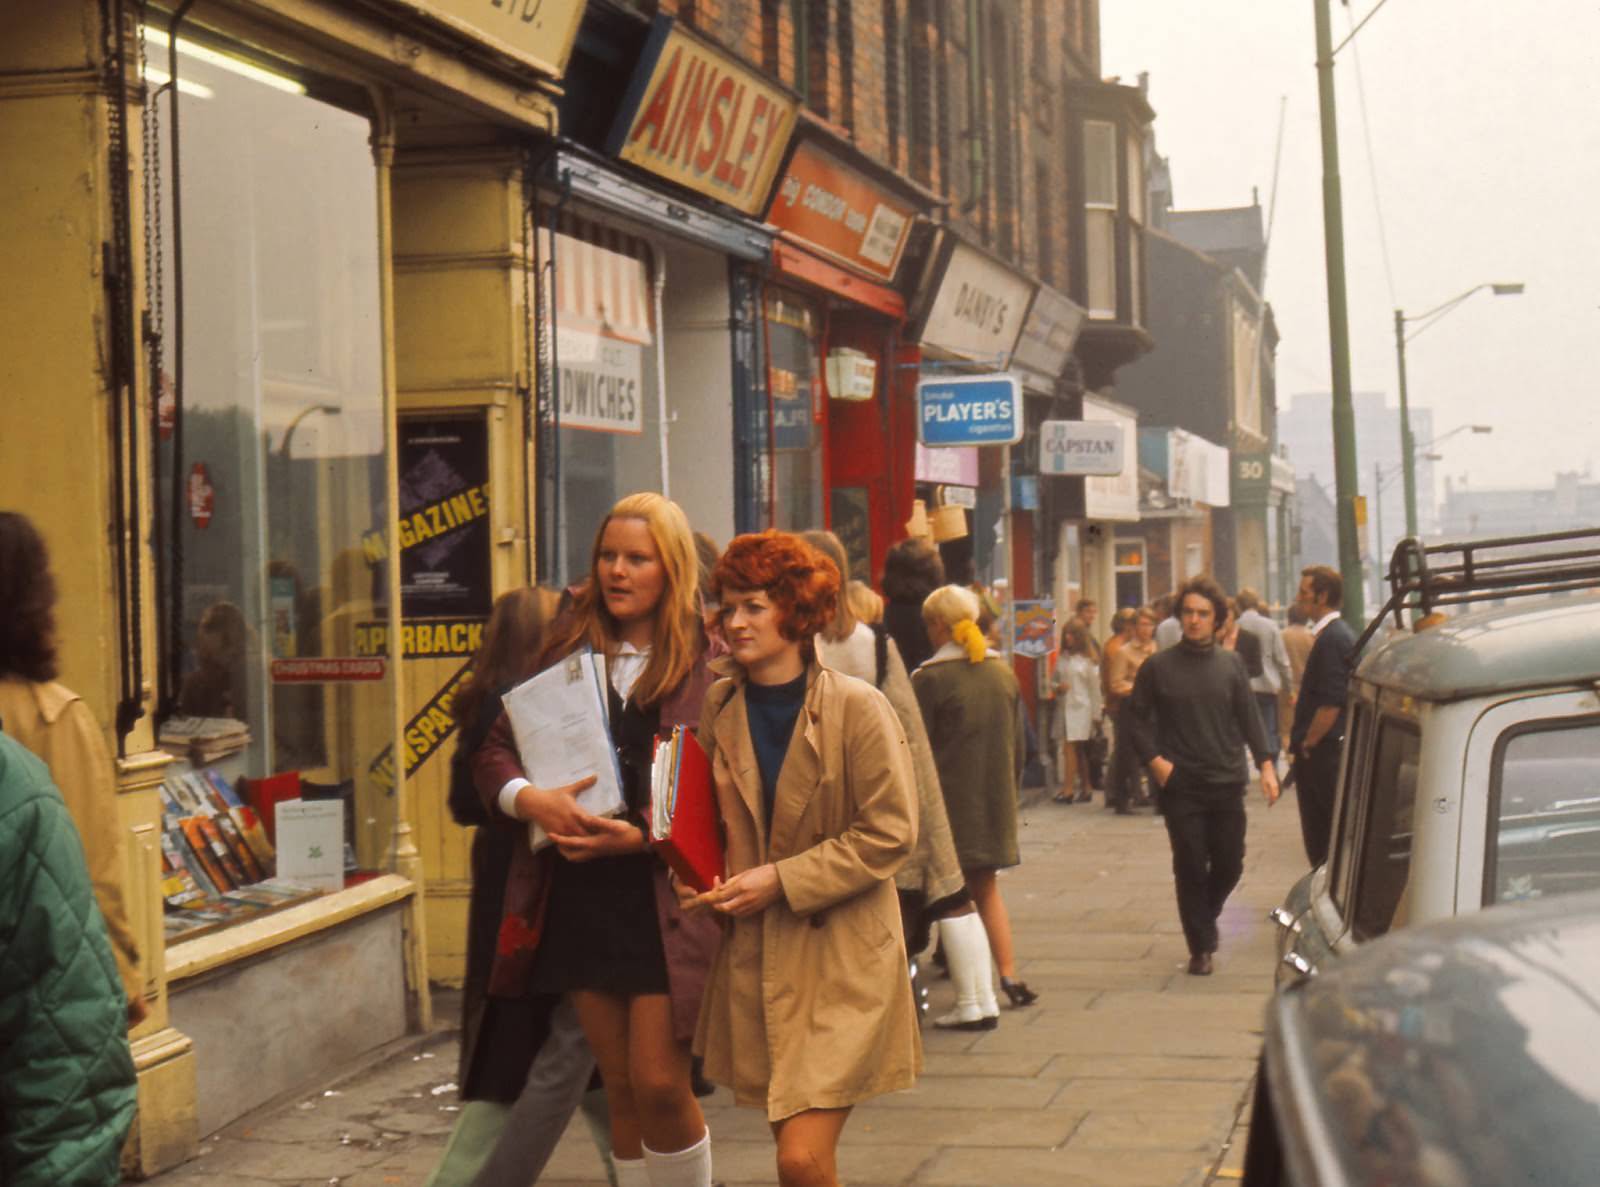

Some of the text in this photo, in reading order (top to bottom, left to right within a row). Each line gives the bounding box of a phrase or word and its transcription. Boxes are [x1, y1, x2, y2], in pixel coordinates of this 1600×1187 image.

[629, 46, 787, 191] AINSLEY
[563, 368, 635, 421] DWICHES
[924, 399, 1012, 422] PLAYER'S
[1046, 438, 1115, 454] CAPSTAN
